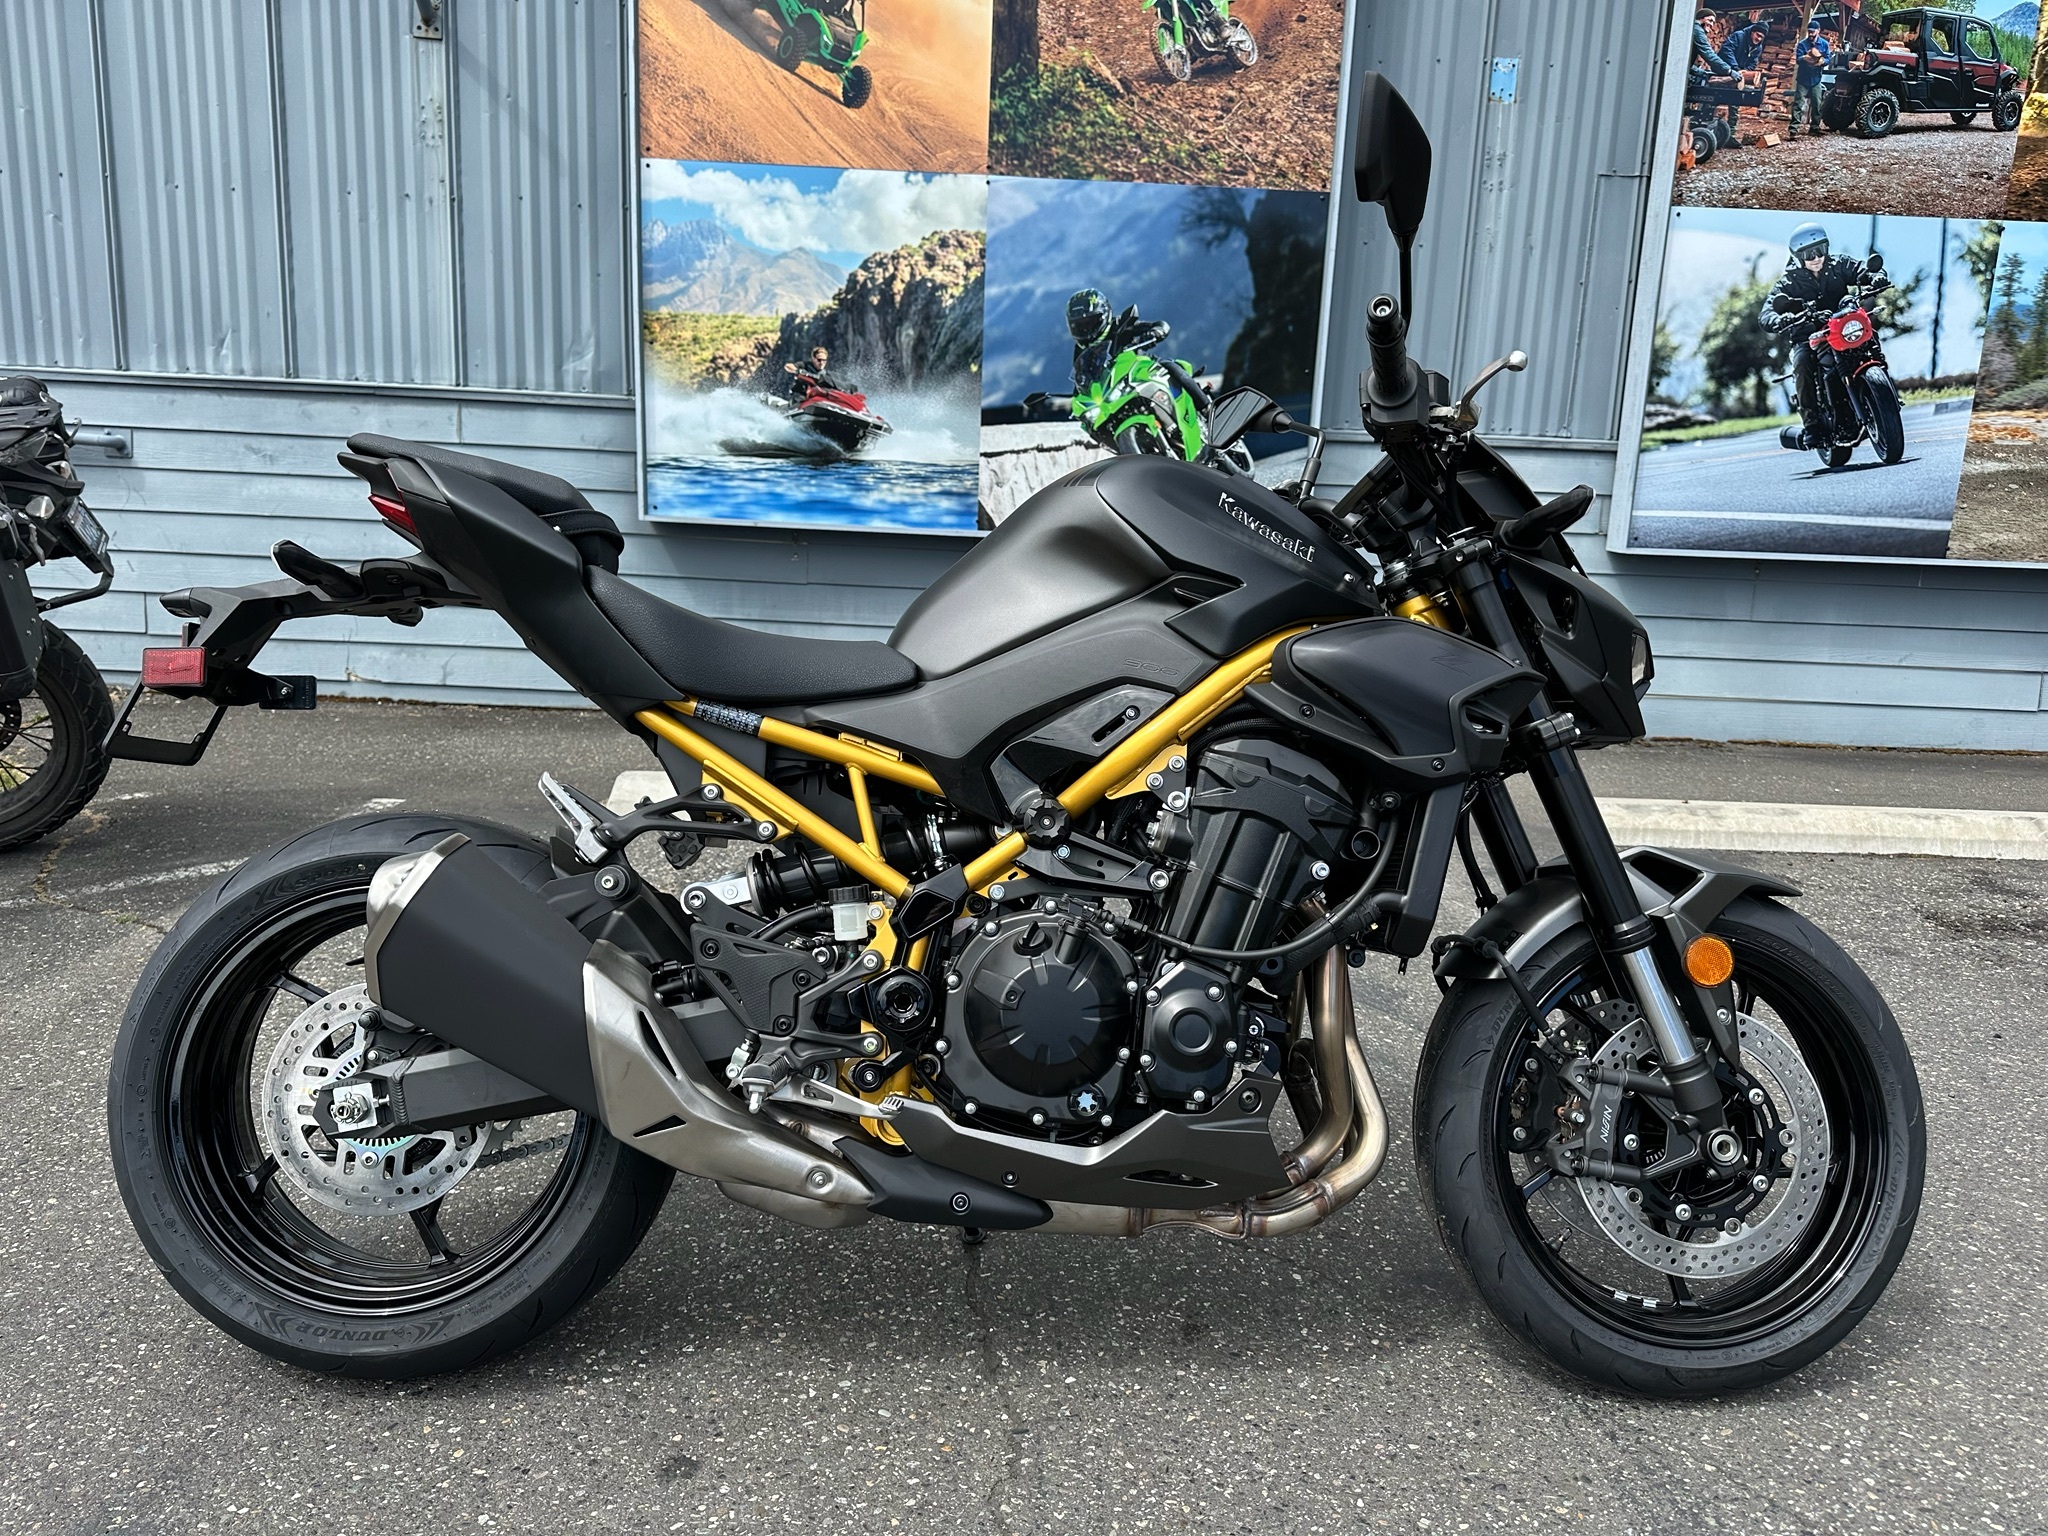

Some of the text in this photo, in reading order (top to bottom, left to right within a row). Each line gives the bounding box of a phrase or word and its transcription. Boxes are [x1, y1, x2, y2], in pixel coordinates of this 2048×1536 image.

[1218, 491, 1317, 563] Kawasaki
[1491, 974, 1533, 1035] DUNLP
[1599, 1103, 1613, 1144] NISSIN
[1874, 1182, 1898, 1246] DUNLOP
[295, 1323, 389, 1342] DUNLOP
